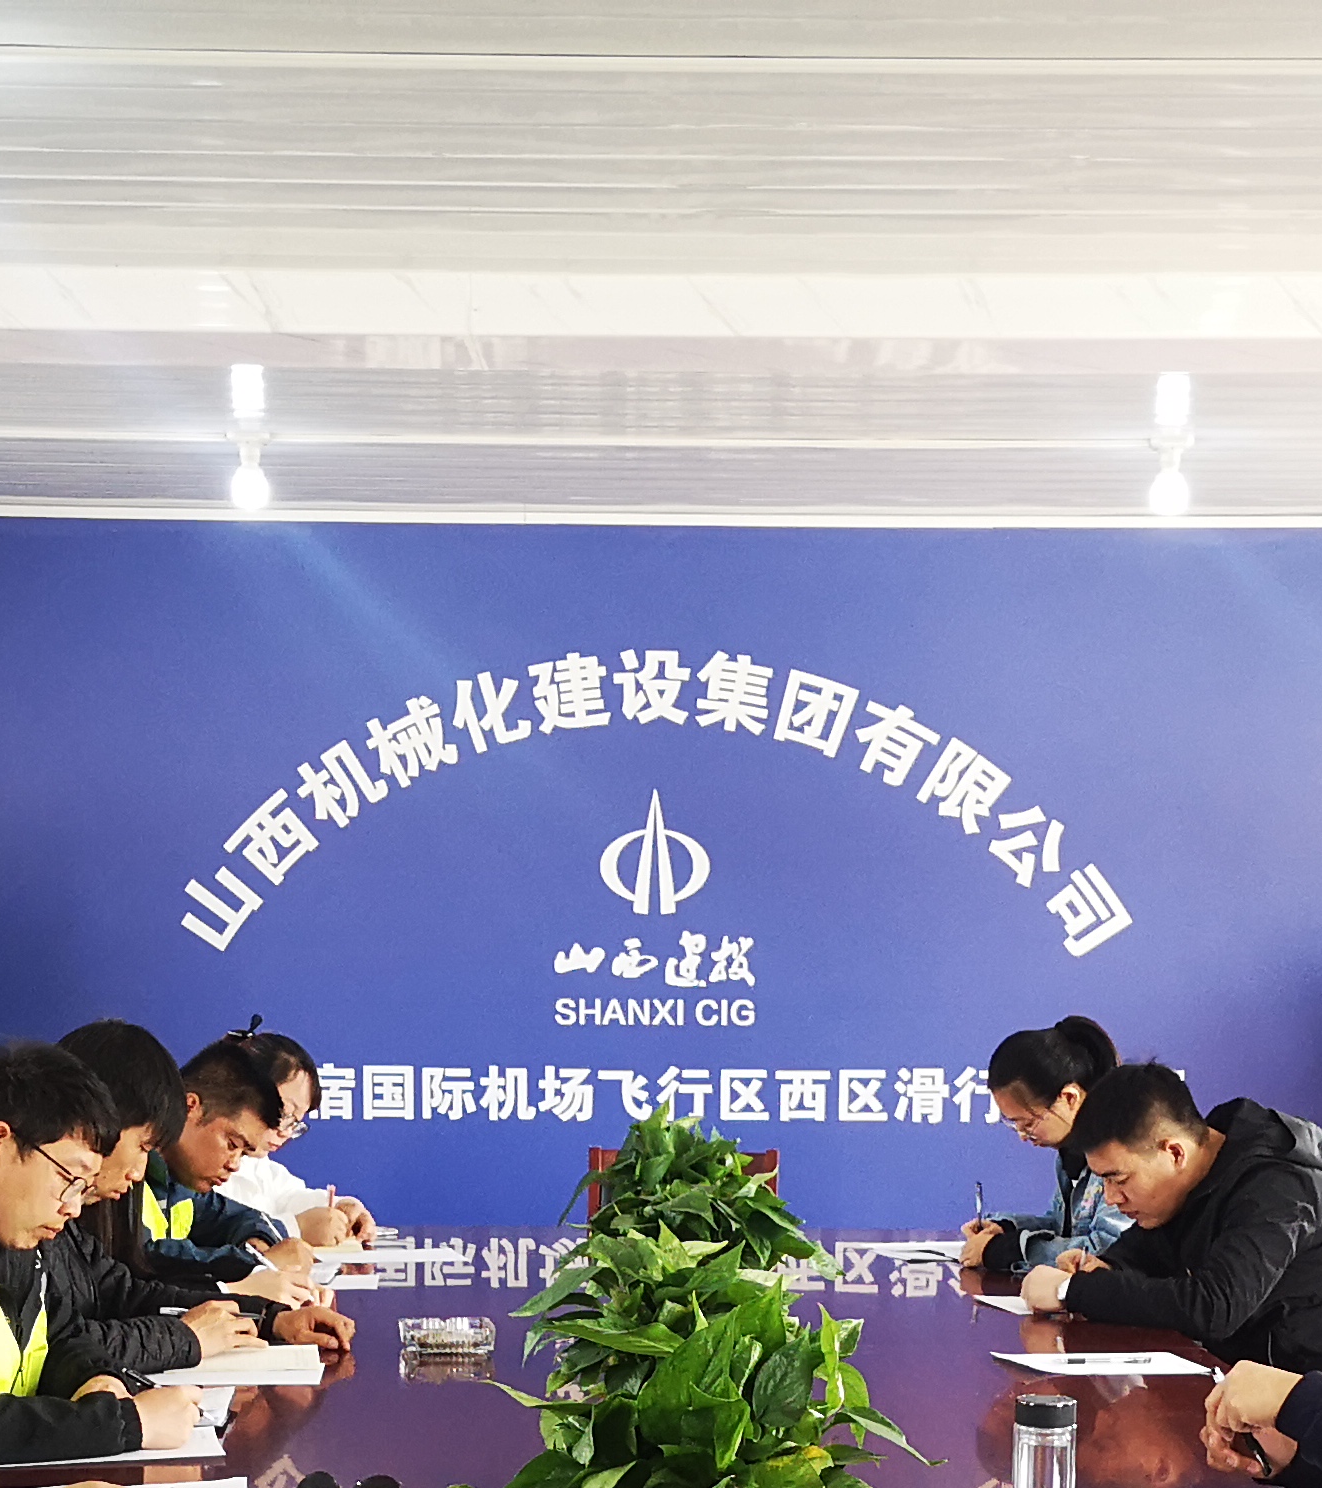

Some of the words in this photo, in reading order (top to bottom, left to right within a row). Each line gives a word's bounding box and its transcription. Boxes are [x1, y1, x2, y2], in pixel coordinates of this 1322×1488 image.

[180, 648, 1133, 957] 山西机械化建设集团有限公司
[553, 930, 756, 988] 山西建投
[554, 998, 685, 1026] SHANXI
[695, 998, 755, 1027] CIG
